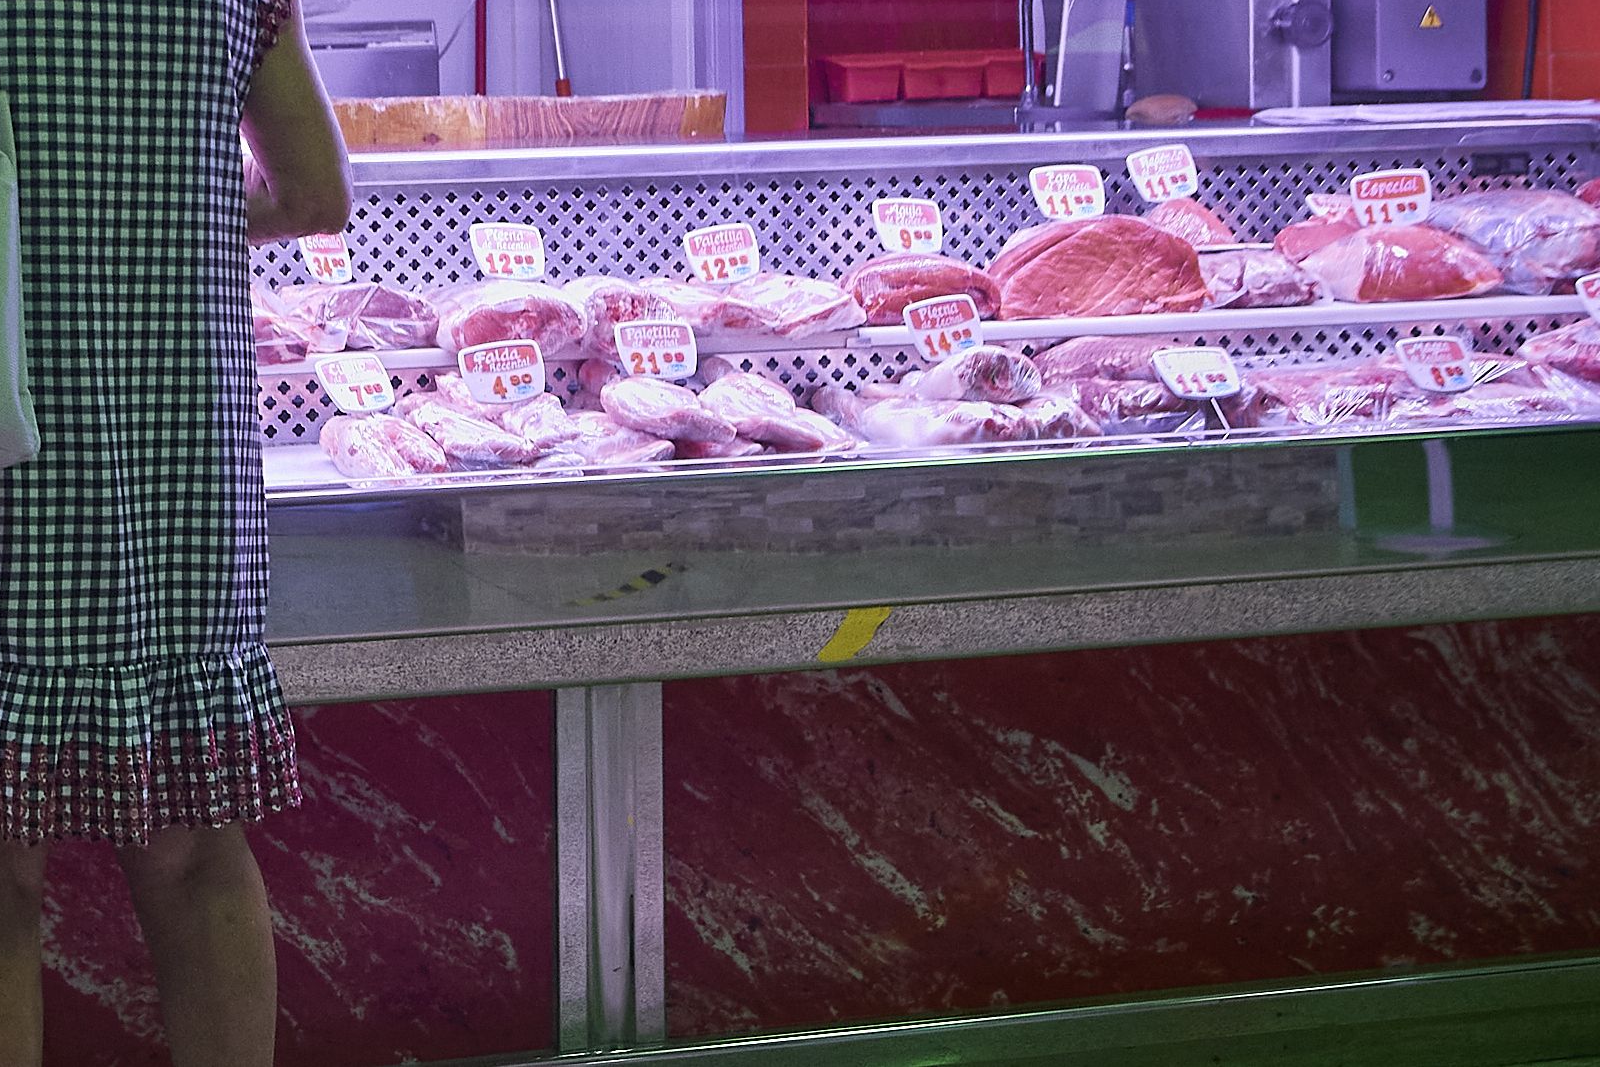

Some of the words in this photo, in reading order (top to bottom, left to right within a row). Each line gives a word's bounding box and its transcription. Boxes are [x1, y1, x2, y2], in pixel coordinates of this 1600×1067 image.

[1361, 176, 1418, 197] Especial
[693, 228, 743, 248] Paletilla
[626, 325, 681, 342] Paletilla
[472, 364, 482, 373] de
[490, 356, 530, 373] Recental
[473, 347, 520, 365] Falda
